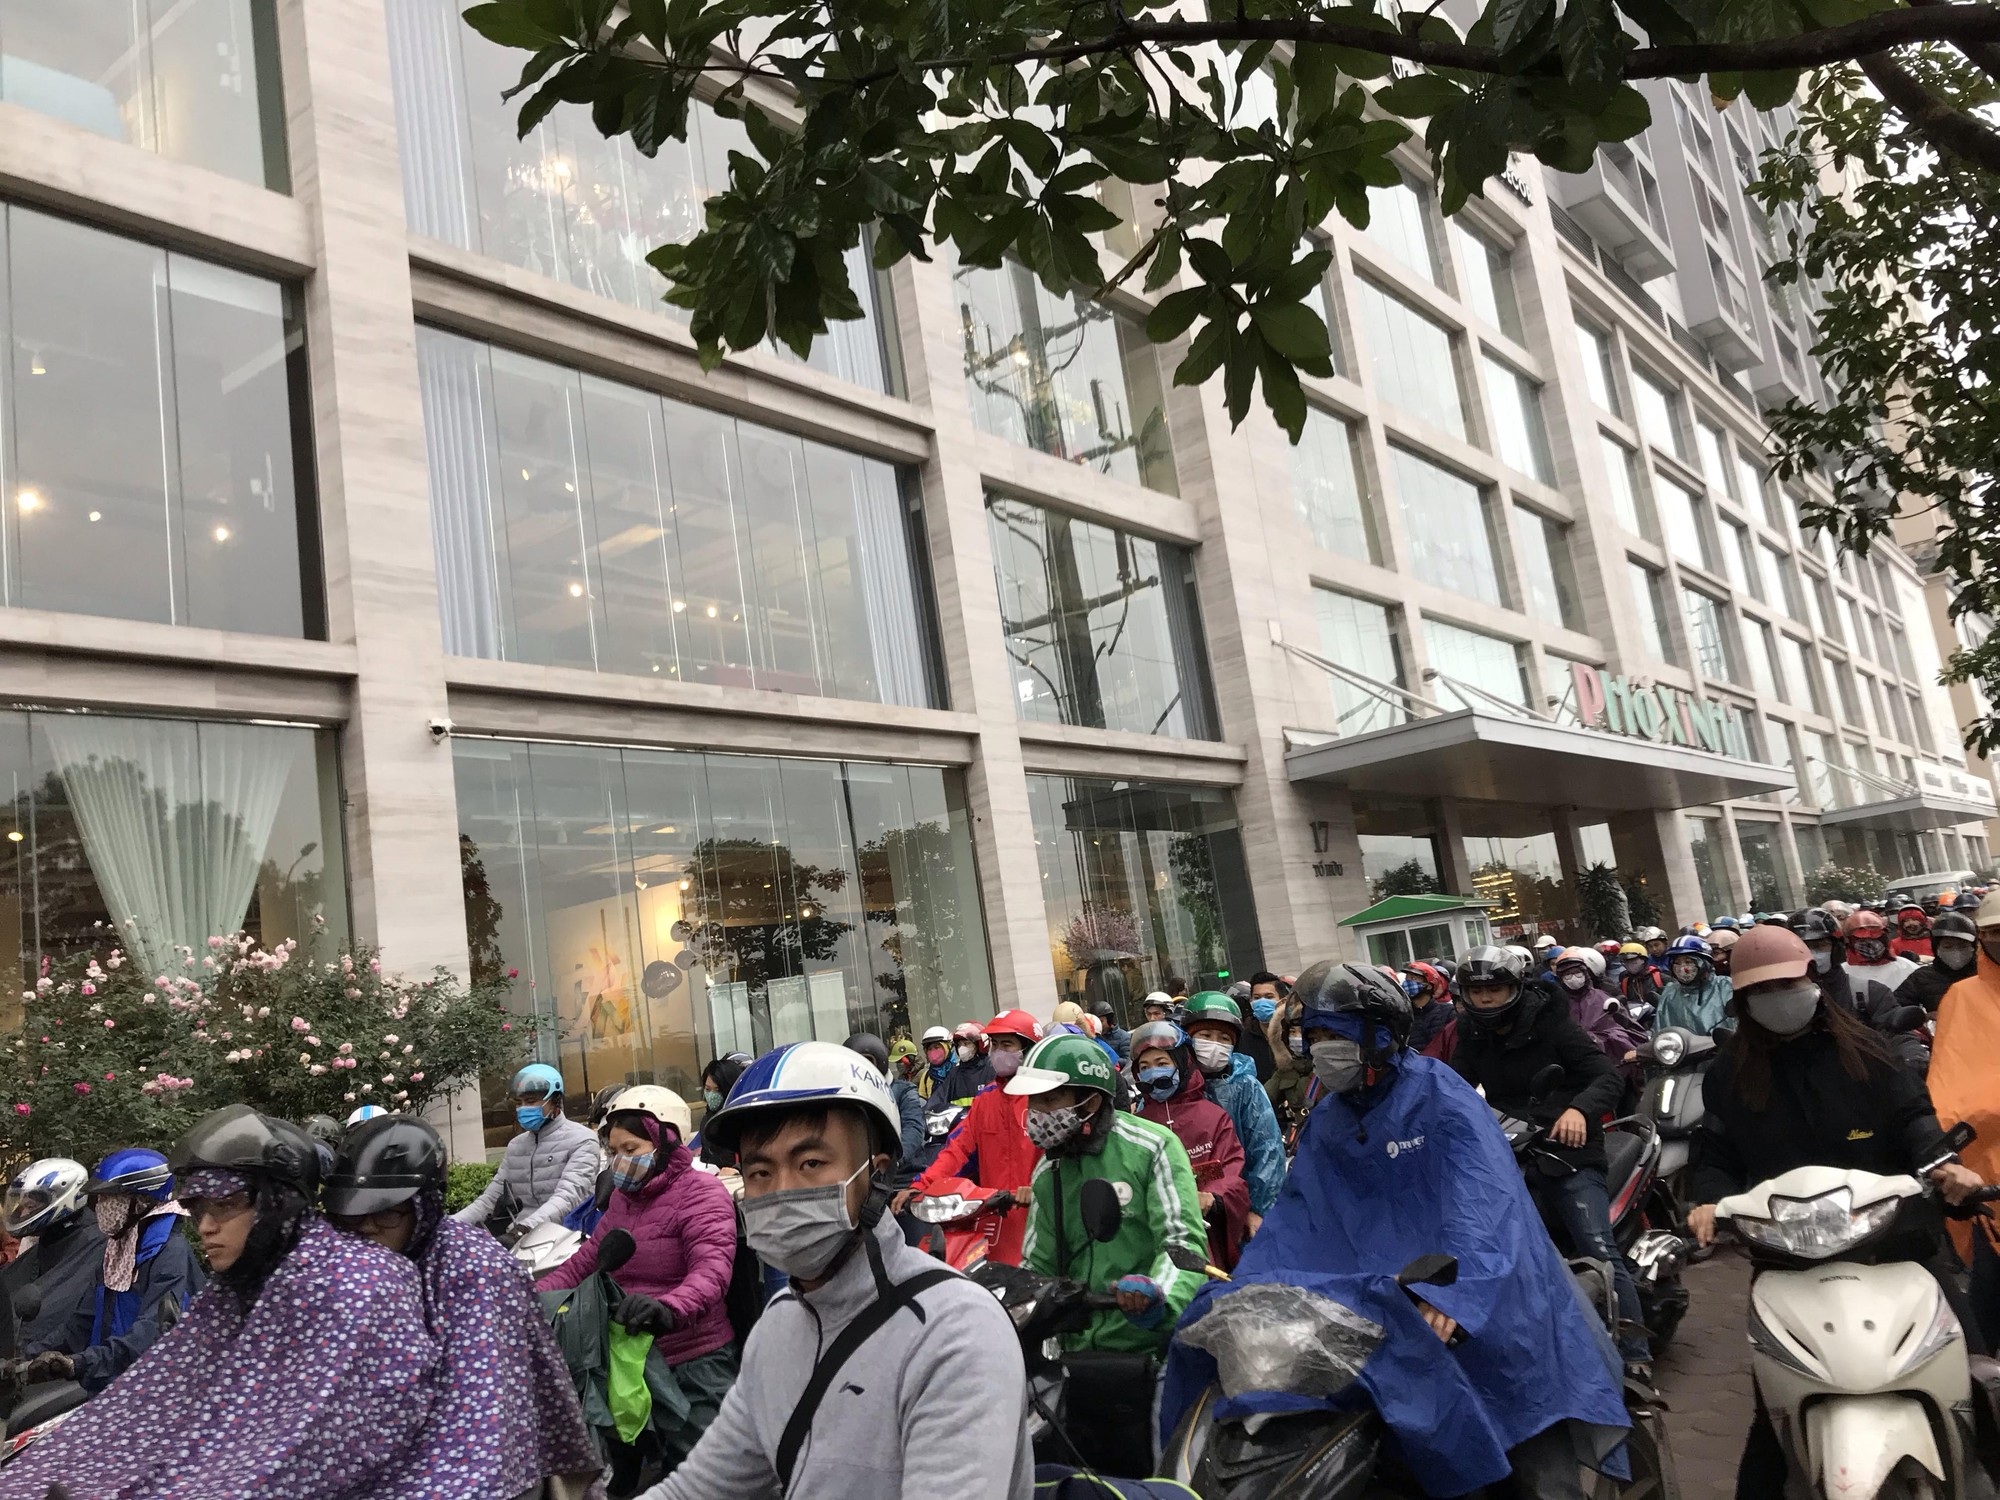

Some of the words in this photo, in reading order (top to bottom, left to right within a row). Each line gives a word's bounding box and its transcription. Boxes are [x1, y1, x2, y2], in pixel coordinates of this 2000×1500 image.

[1309, 821, 1329, 853] 17
[1205, 1004, 1231, 1012] HONDA
[1077, 1060, 1110, 1080] Grab
